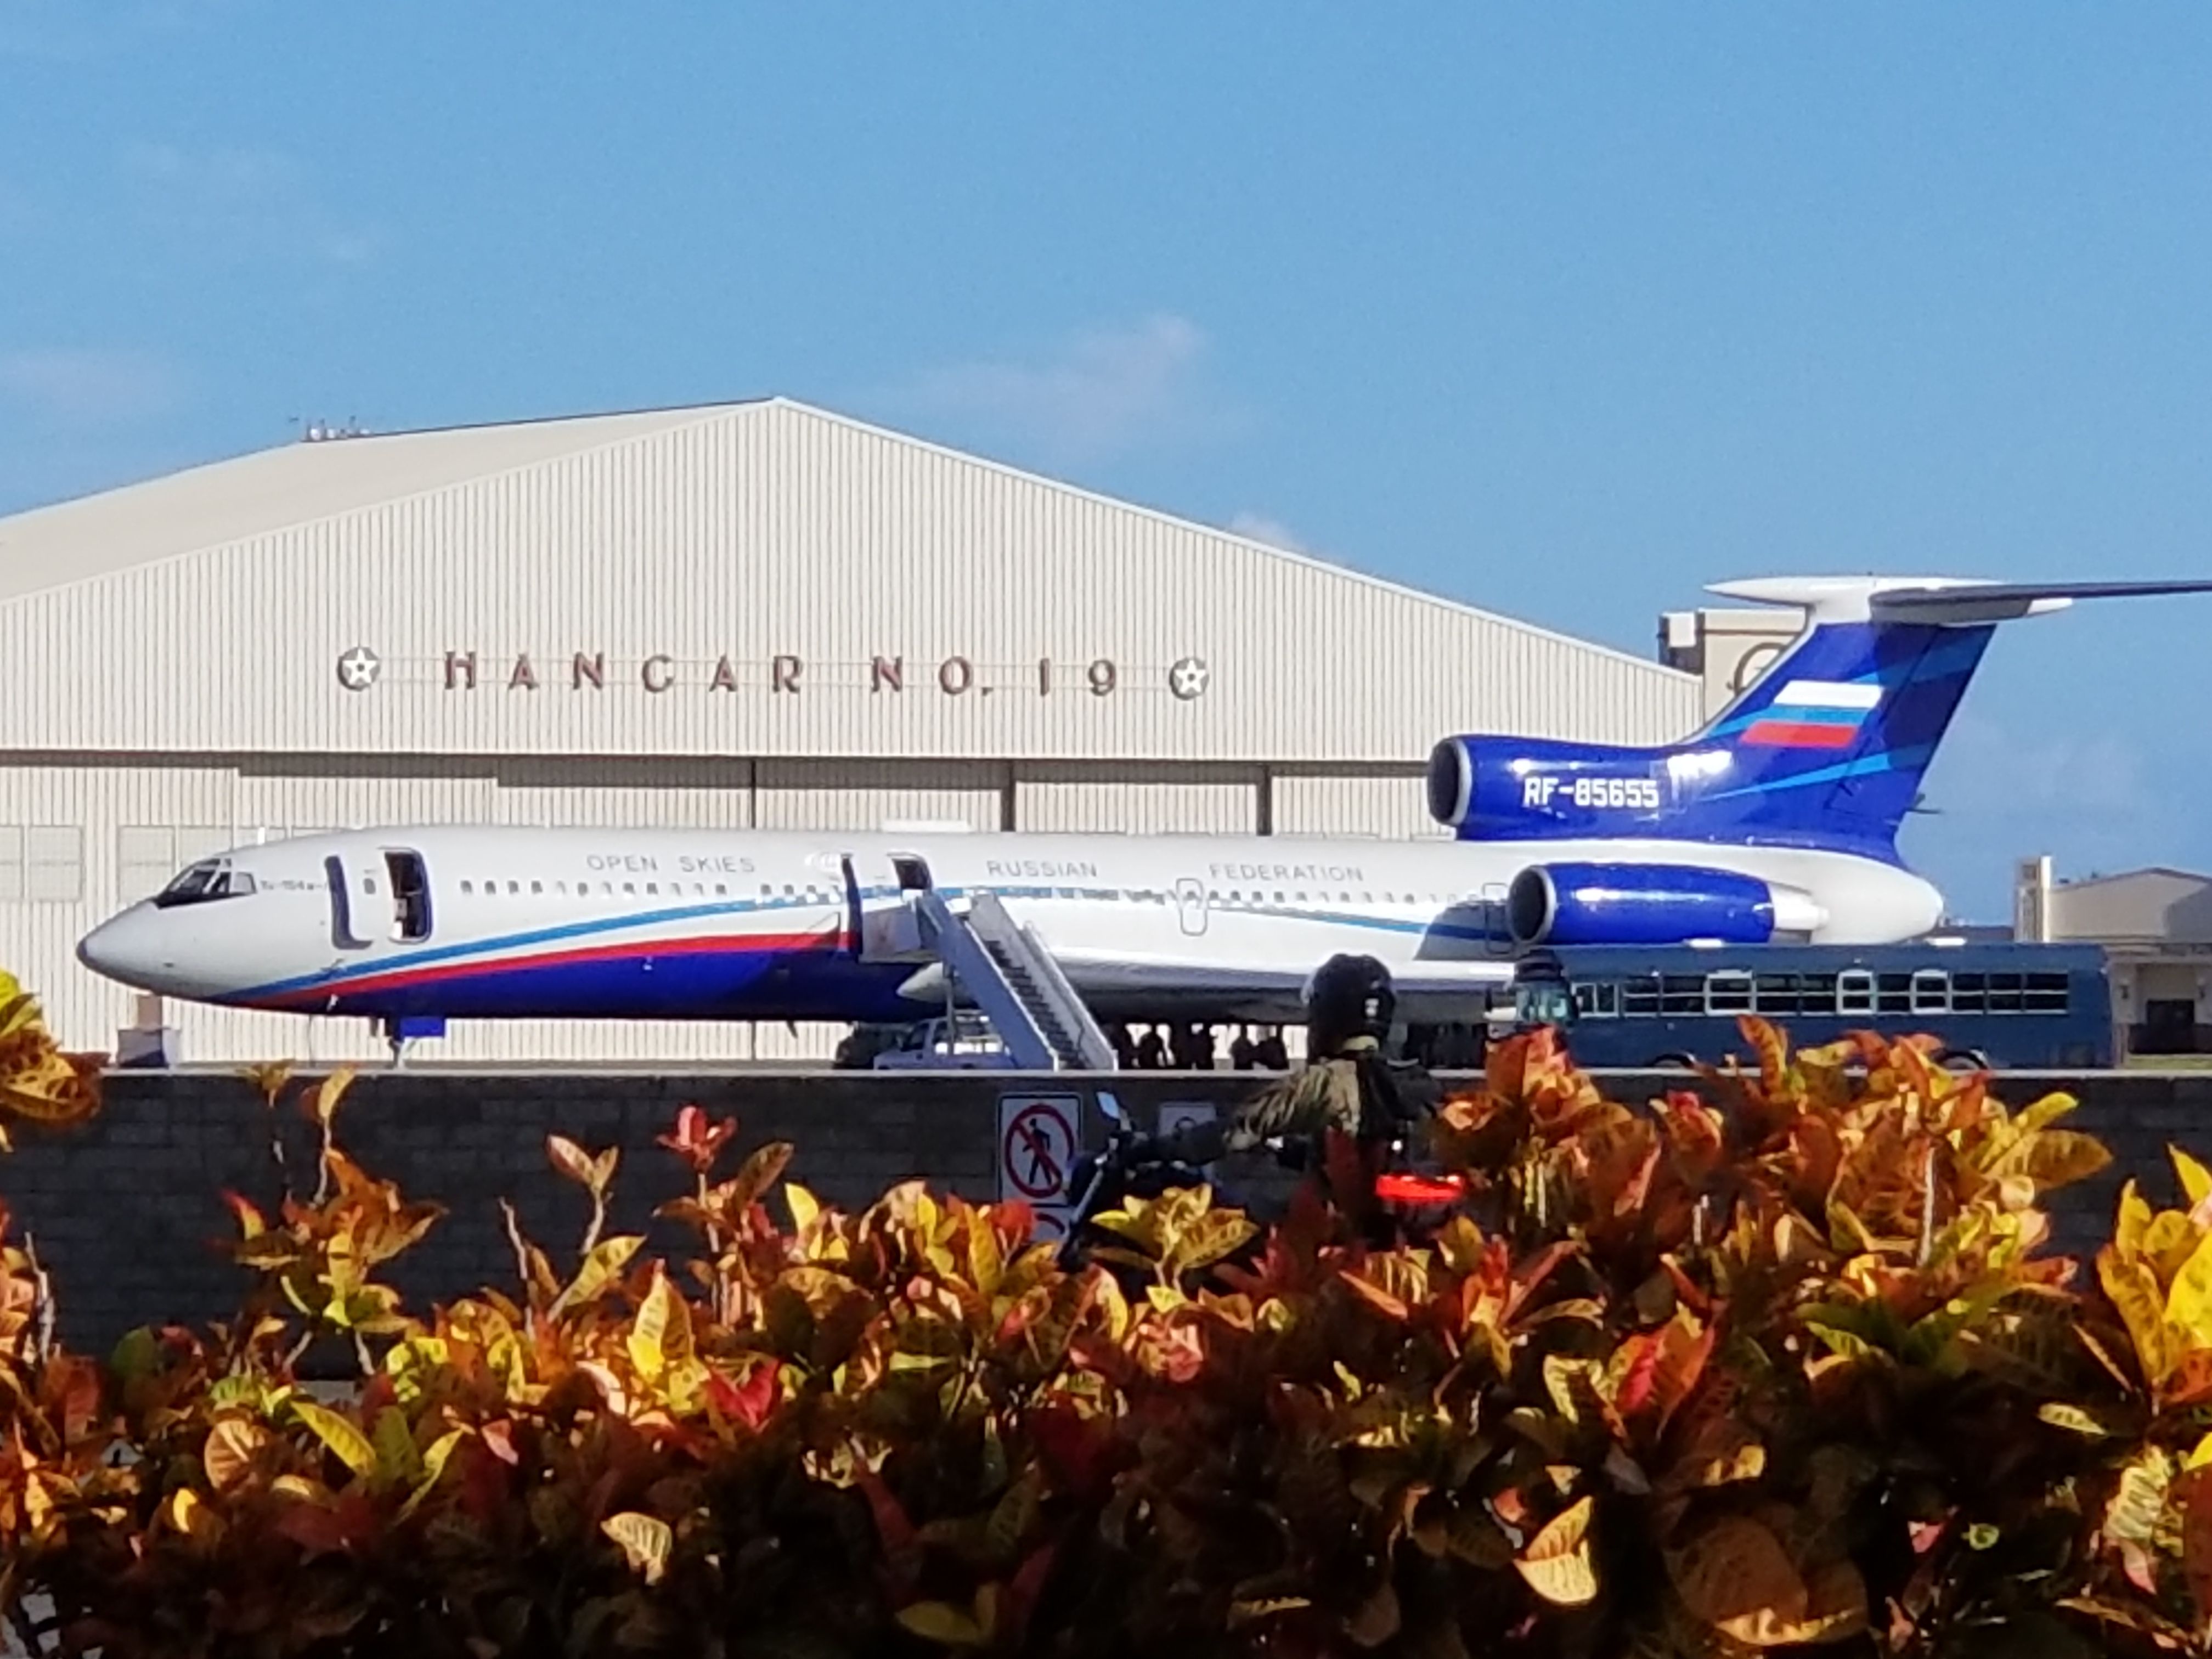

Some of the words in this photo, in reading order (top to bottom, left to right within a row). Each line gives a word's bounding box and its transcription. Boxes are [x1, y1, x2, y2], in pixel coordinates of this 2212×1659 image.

[445, 651, 803, 693] HANGAR
[871, 656, 992, 695] NO.
[1039, 658, 1117, 696] 19
[1523, 777, 1660, 808] RF-85655
[586, 855, 657, 872] OPEN
[679, 856, 755, 873] SKIES
[986, 860, 1097, 878] RUSSIAN
[1210, 863, 1364, 882] FEDERATION
